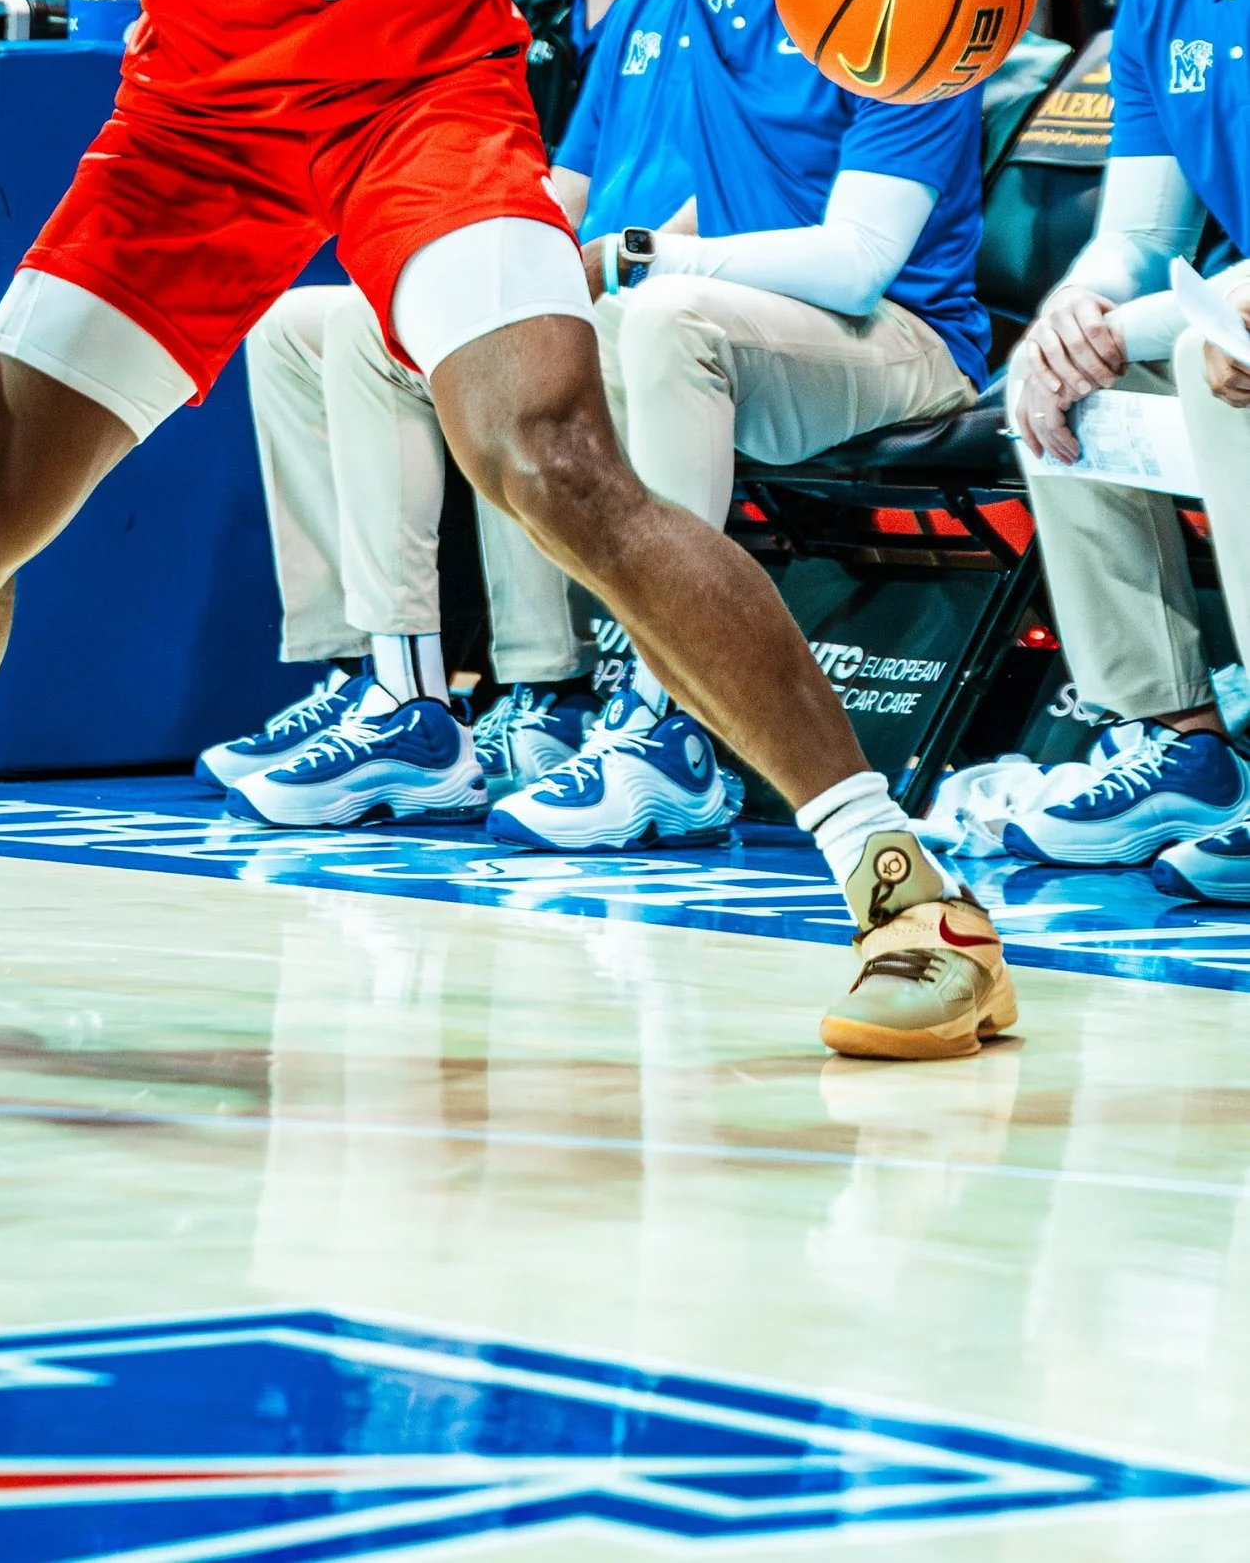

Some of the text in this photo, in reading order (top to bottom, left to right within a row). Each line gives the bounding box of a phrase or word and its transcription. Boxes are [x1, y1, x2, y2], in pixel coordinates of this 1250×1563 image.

[859, 655, 947, 682] EUROPEAN
[842, 688, 880, 712] CAR
[876, 690, 922, 714] CARE
